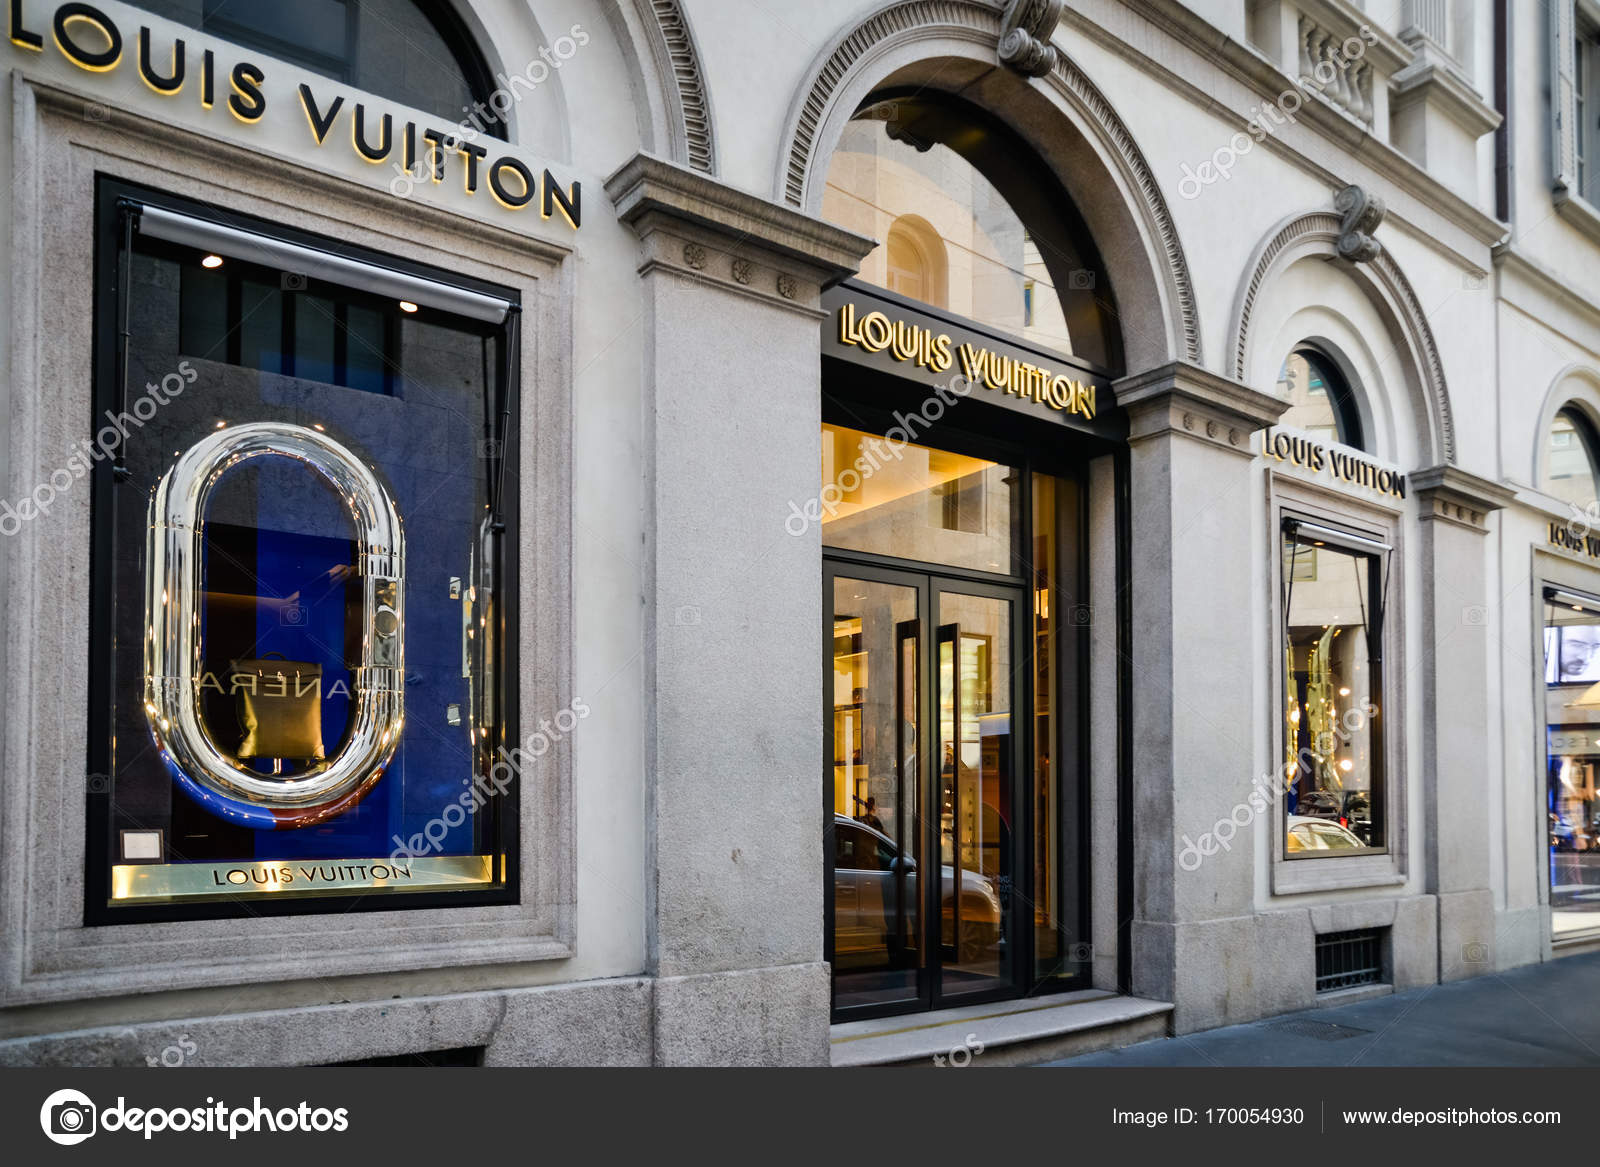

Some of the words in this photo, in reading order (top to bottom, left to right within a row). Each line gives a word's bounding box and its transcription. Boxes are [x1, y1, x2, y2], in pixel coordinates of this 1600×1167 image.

[9, 0, 267, 124] LOUIS
[298, 83, 582, 229] VUITTON
[841, 303, 952, 373] LOUIS
[957, 343, 1097, 421] VUITTON
[1262, 428, 1325, 473] LOUIS
[1328, 450, 1406, 499] VUITTON
[213, 867, 294, 886] LOUIS
[300, 864, 411, 883] VUITTON
